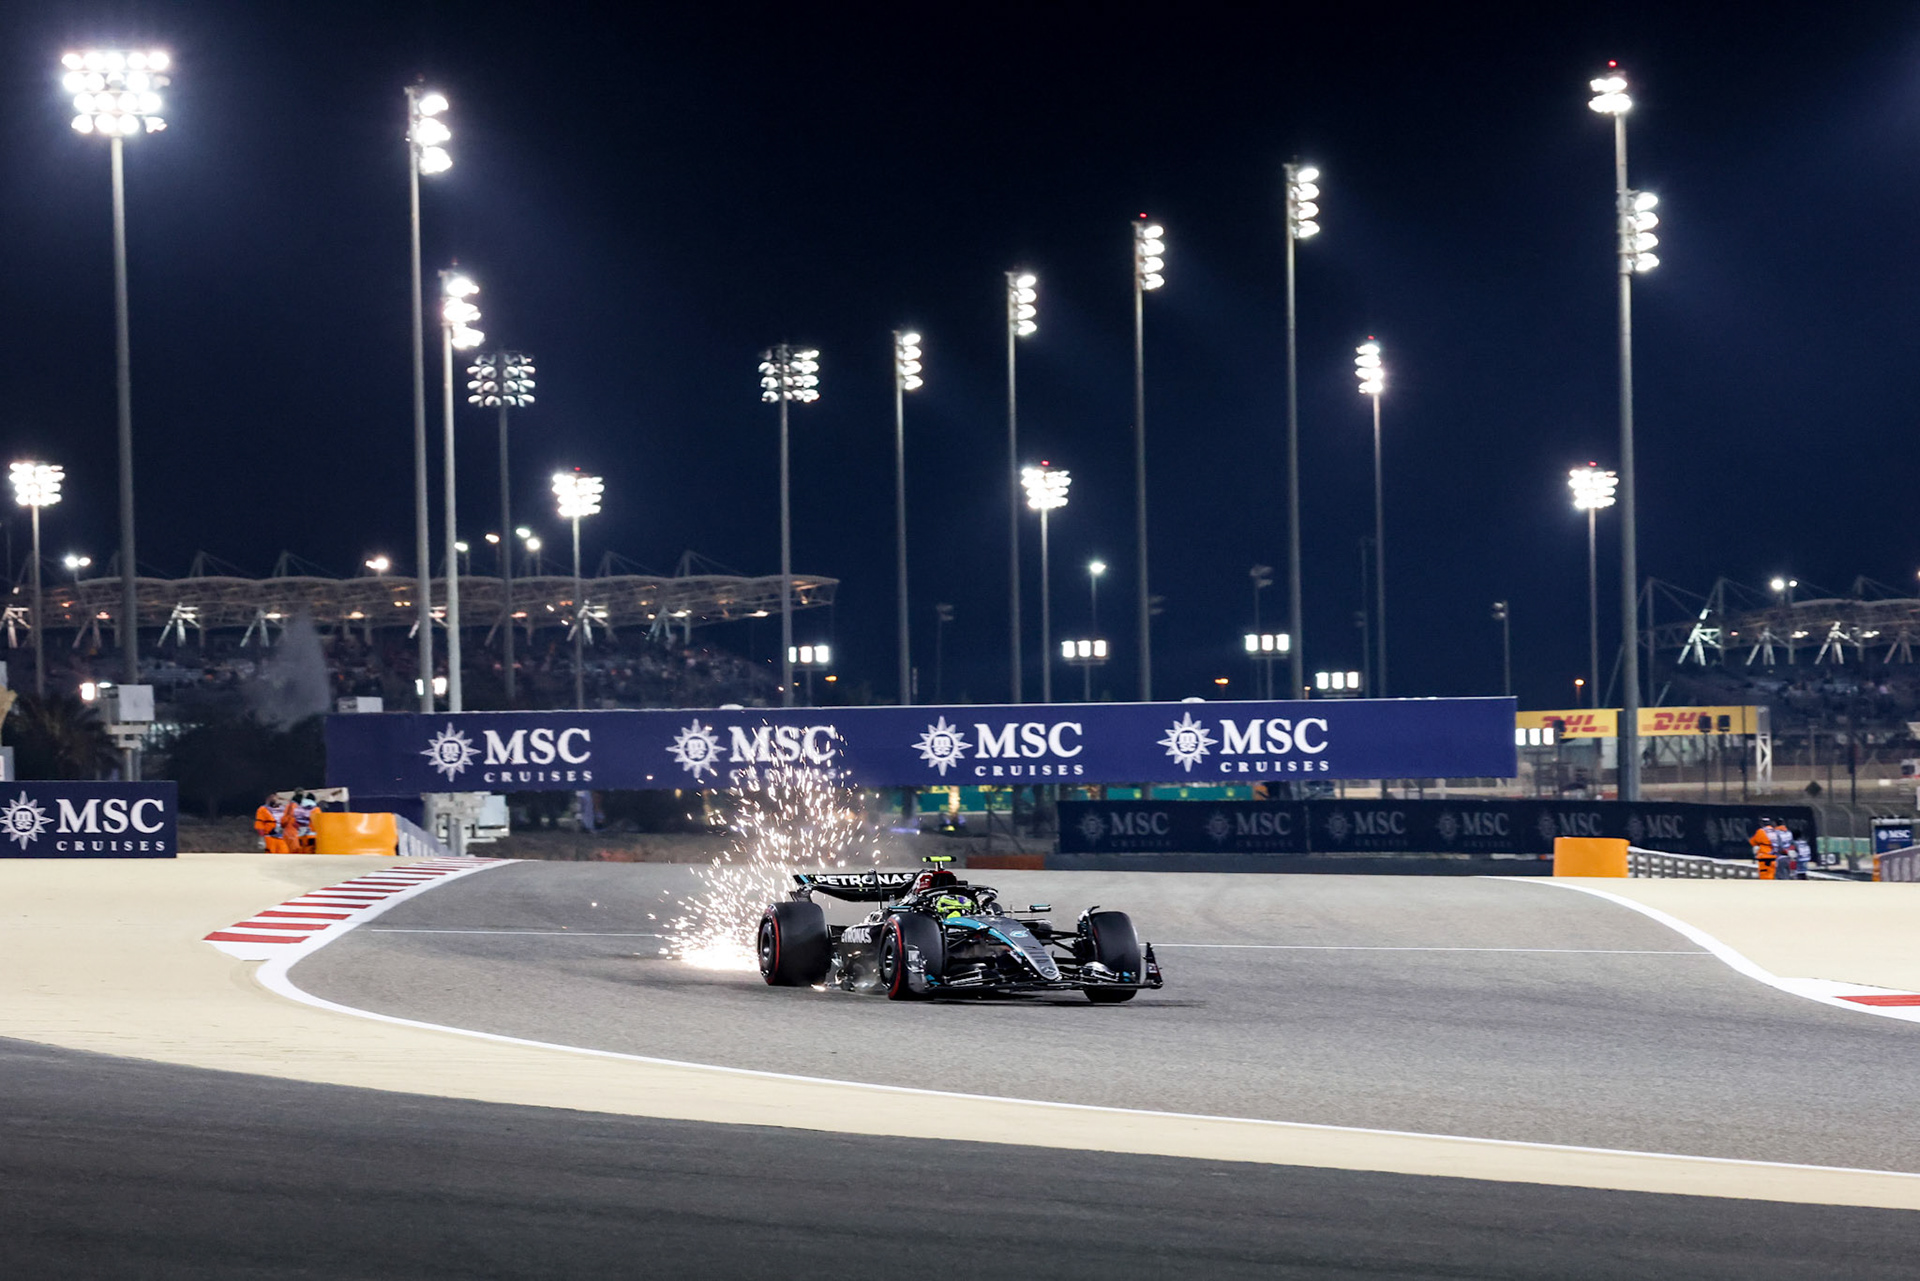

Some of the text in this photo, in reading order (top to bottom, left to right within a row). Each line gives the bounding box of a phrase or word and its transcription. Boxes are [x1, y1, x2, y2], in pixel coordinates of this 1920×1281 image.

[1653, 711, 1707, 730] DH
[483, 728, 591, 765] MSC
[728, 725, 836, 763] MSC
[973, 722, 1083, 758] MSC
[1219, 717, 1328, 755] MSC
[484, 770, 592, 783] CRUISES
[974, 764, 1084, 777] CRUISES
[1219, 760, 1329, 773] CRUISES
[55, 798, 164, 833] MSC
[1110, 812, 1170, 835] MSC
[1235, 812, 1291, 835] MSC
[1353, 811, 1406, 835] MSC
[1461, 812, 1509, 836] MSC
[1558, 812, 1604, 837] MSC
[1646, 815, 1685, 839] MSC
[56, 840, 165, 852] CRUISES
[814, 873, 914, 886] PETRONAS
